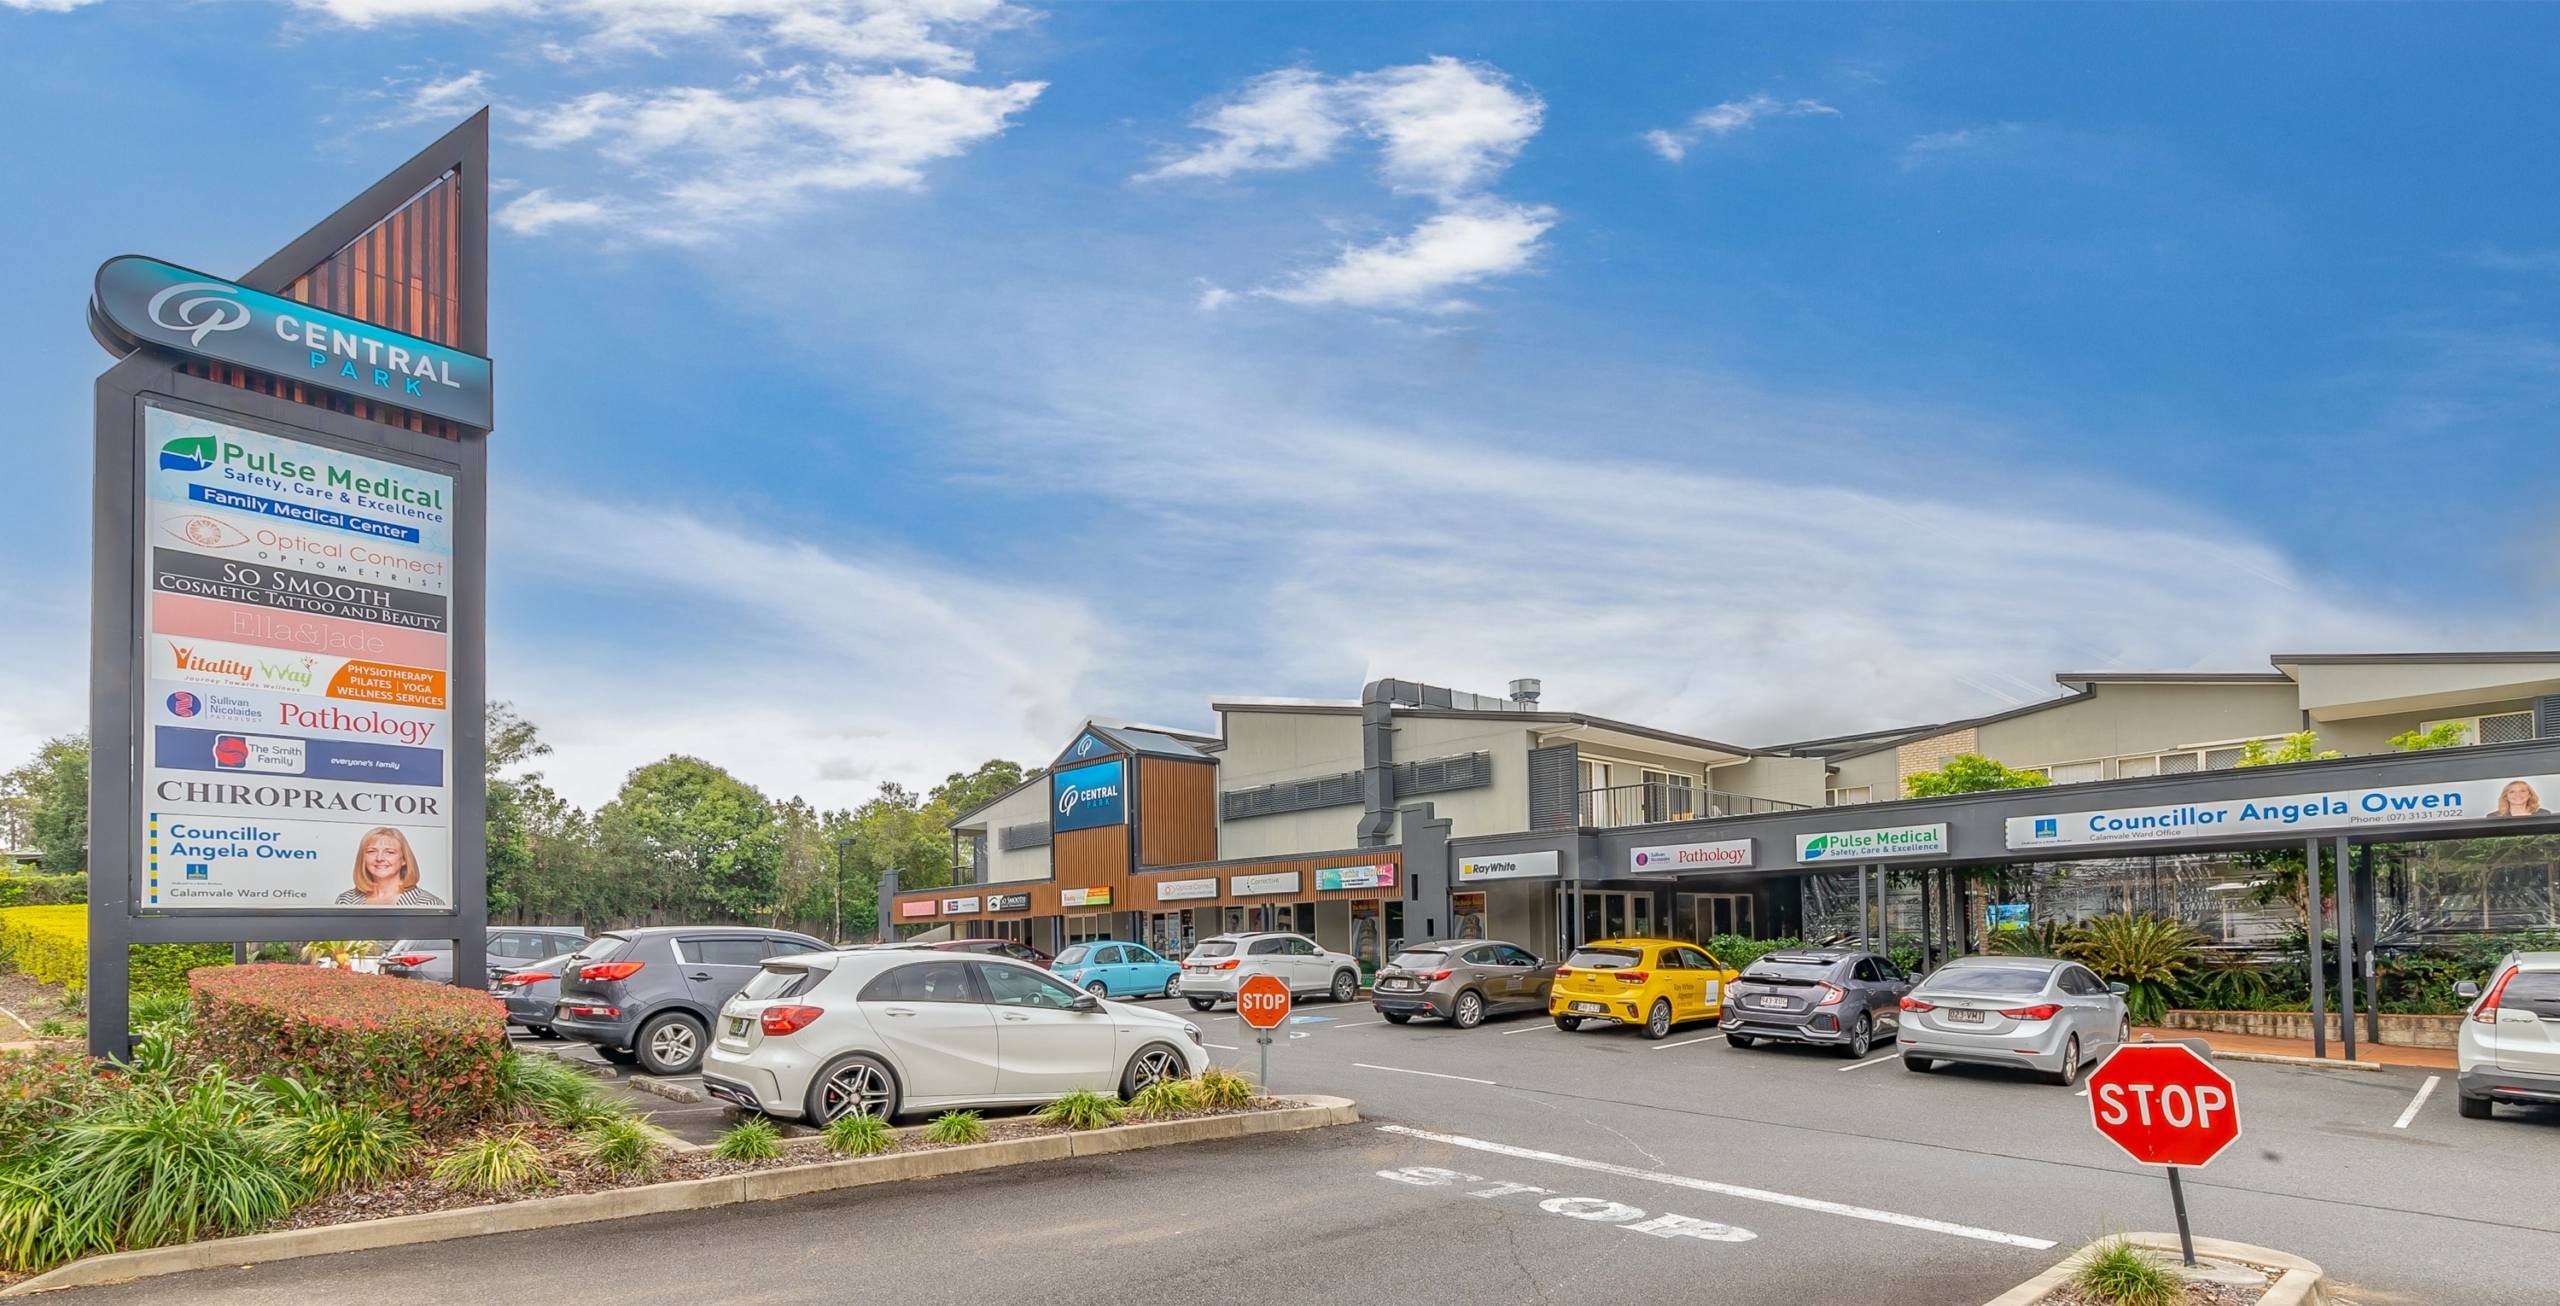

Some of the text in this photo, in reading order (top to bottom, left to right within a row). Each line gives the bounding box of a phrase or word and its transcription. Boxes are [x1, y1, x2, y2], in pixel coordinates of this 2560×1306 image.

[276, 314, 460, 388] CENTRAL
[310, 350, 422, 397] PARK
[223, 442, 443, 510] Pulse Medical
[224, 468, 443, 523] Safety, Care & Excellence
[204, 489, 408, 539] Family Medical Center
[257, 529, 444, 576] Optical Connect
[258, 551, 443, 589] OPTOMETRIST
[223, 563, 391, 608] SO SMOOTH
[159, 575, 441, 631] COSMETIC TATTOO AND BEAUTY
[231, 610, 385, 654] Ella&Jade
[166, 638, 313, 688] Vitality Way
[347, 664, 434, 683] PHYSIOTHERAPY
[184, 675, 301, 692] Journey Towards Wellness
[350, 676, 432, 694] PILATES YOGA
[210, 695, 249, 707] Sullivan
[337, 686, 444, 706] WELLNESS SERVICES
[210, 705, 262, 717] Nicolaides
[210, 714, 262, 723] PATHOLOGY
[279, 702, 436, 745] Pathology
[249, 744, 302, 757] The Smith
[258, 754, 294, 767] Family
[330, 757, 401, 771] everyone's family
[156, 780, 439, 816] CHIROPRACTOR
[1080, 785, 1118, 802] CENTRAL
[1086, 798, 1110, 809] PARK
[2089, 792, 2462, 832] Councillor Angela Owen
[2350, 809, 2463, 824] Phone: (07) 3131 7022
[170, 824, 281, 843] Councillor
[1830, 828, 1938, 848] Pulse Medical
[2089, 828, 2181, 842] Calamvale Ward Office
[170, 842, 317, 861] Angela Owen
[1679, 847, 1746, 864] Pathology
[1830, 843, 1939, 857] Safety, Care & Excellence
[1176, 882, 1214, 892] Optical Connect
[1250, 877, 1280, 885] Corrective
[170, 888, 308, 899] Calamvale Ward Office
[1241, 992, 1287, 1012] STOP
[2100, 1083, 2227, 1130] STOP
[1375, 1165, 1759, 1243] STOP
